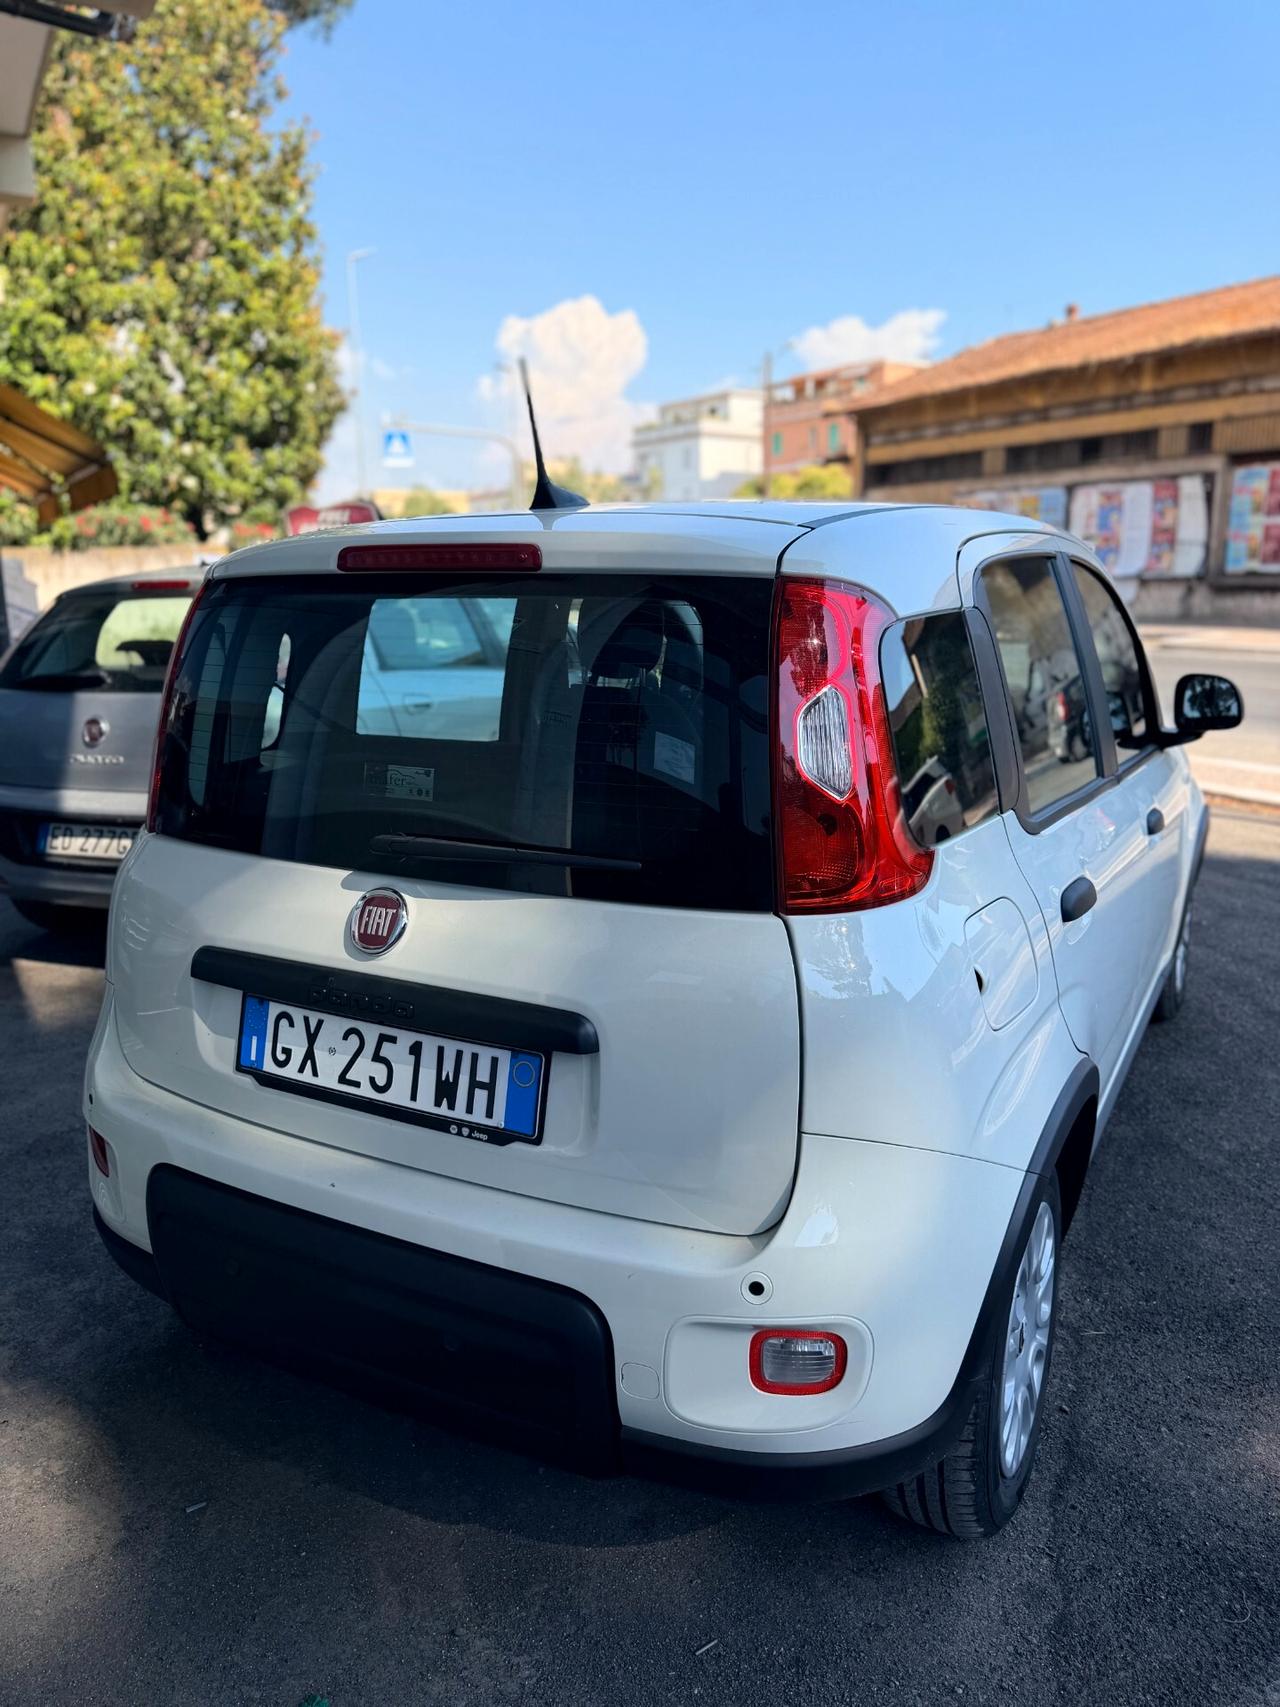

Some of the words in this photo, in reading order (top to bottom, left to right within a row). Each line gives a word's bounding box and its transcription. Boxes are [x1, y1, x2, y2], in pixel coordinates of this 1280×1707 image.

[360, 905, 397, 937] FIAT
[270, 1011, 325, 1078] GX
[337, 1026, 499, 1120] 251WH
[471, 1129, 489, 1142] Jeep
